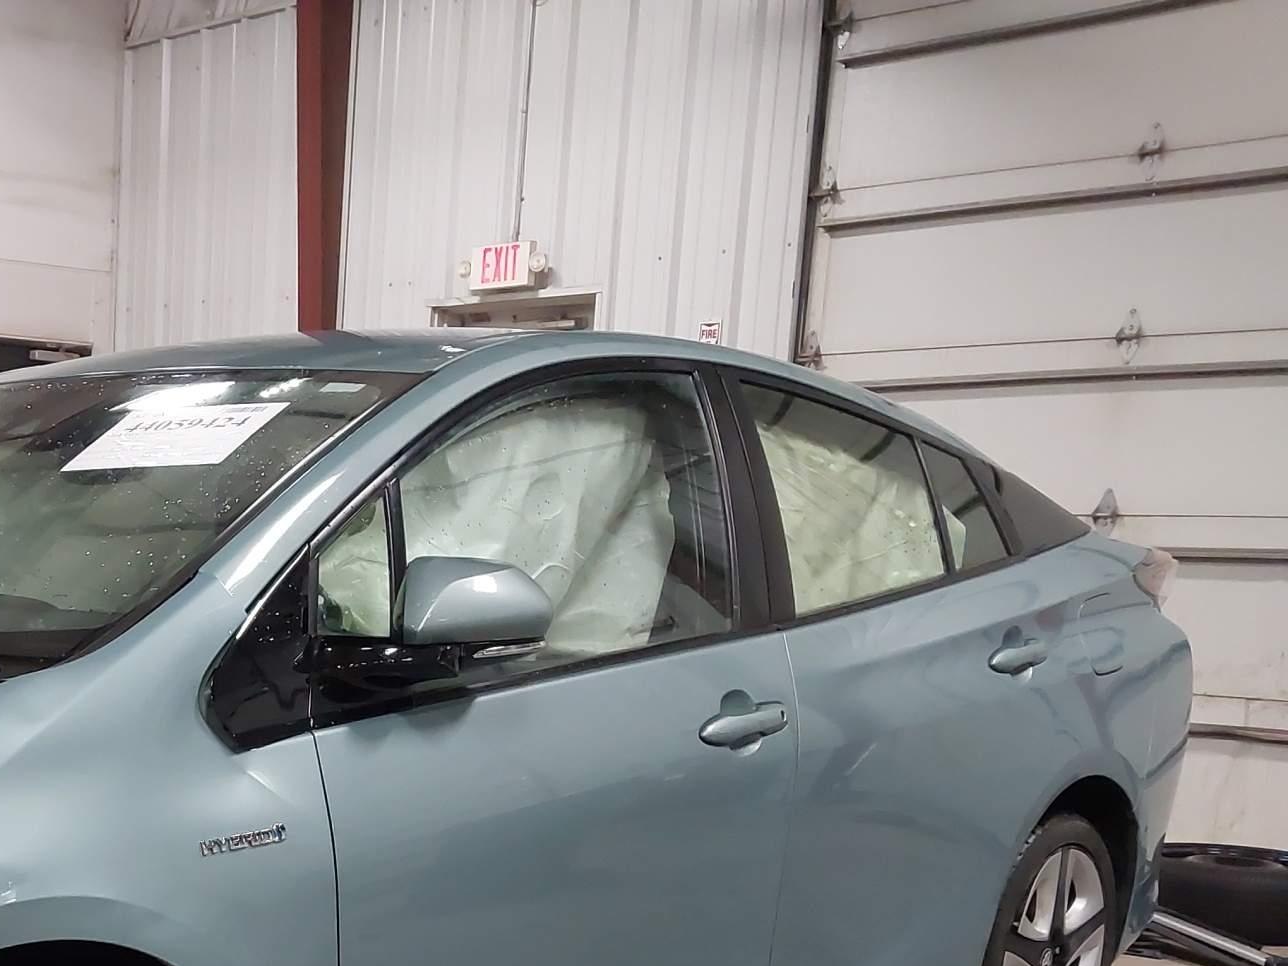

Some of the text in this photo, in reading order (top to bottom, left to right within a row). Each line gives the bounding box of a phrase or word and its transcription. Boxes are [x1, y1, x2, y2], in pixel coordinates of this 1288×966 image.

[480, 244, 520, 284] EXIT
[701, 328, 718, 339] FIRE
[126, 415, 252, 433] 44059424
[199, 823, 287, 857] HYBRID
